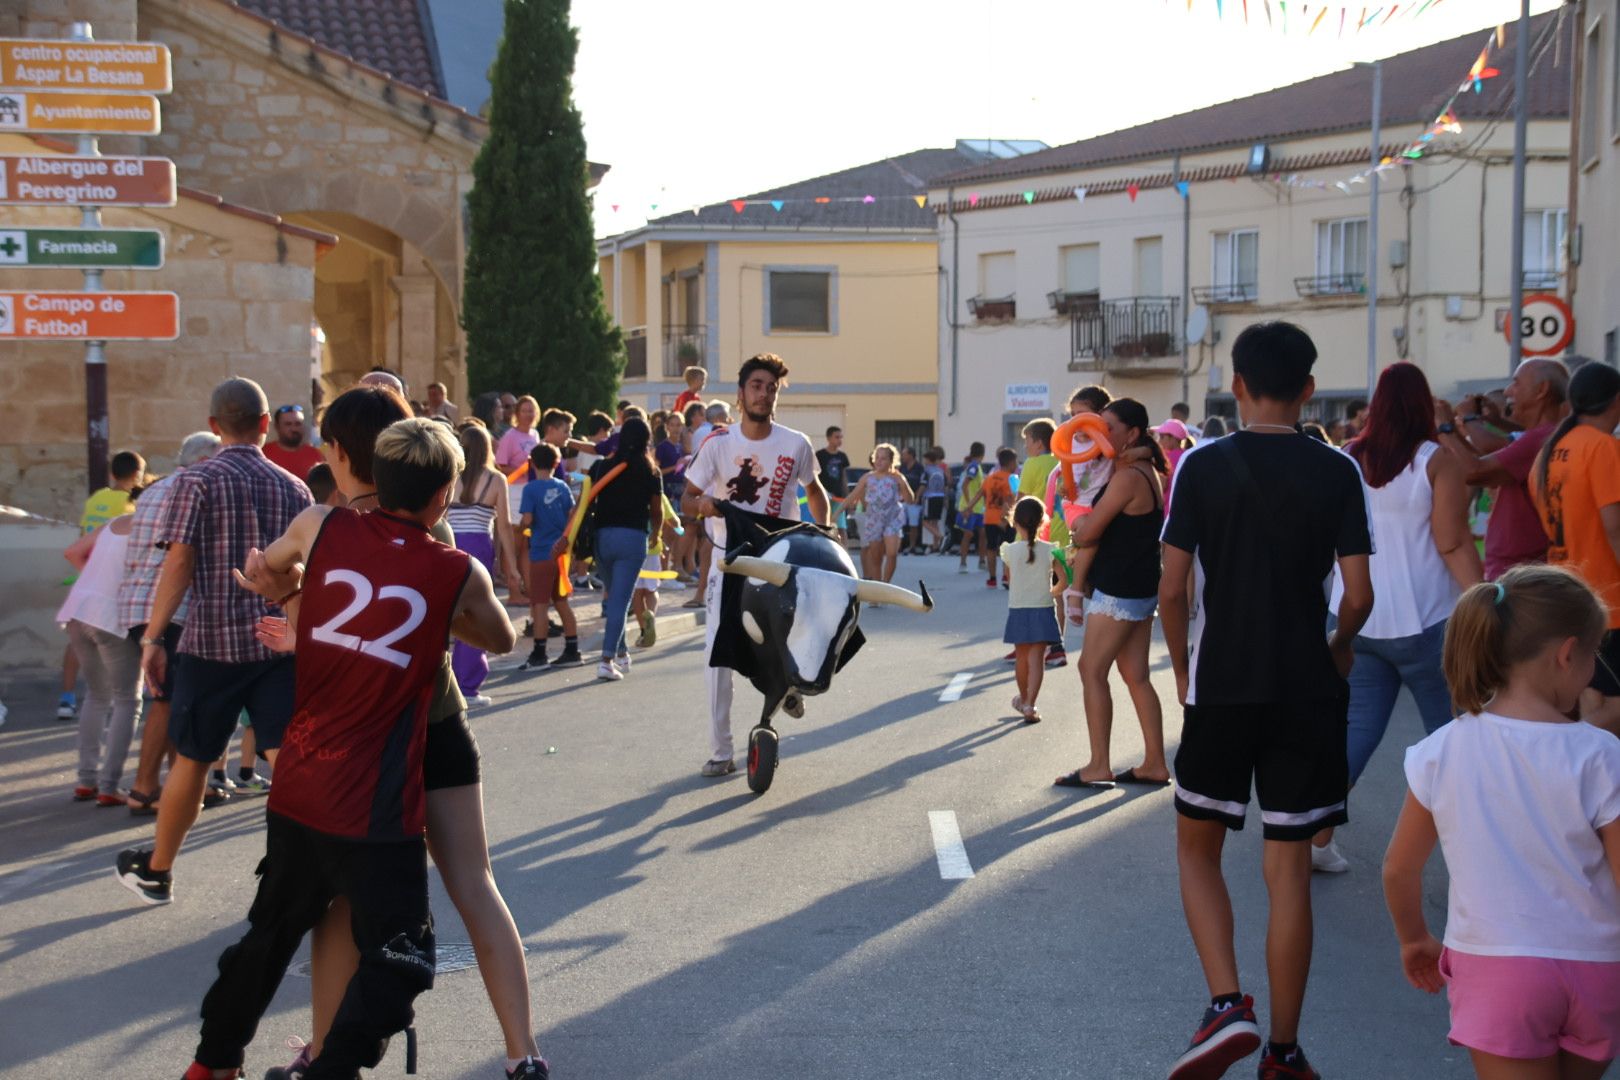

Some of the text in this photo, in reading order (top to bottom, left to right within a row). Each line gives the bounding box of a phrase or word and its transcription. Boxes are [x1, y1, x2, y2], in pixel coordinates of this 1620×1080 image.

[12, 45, 157, 64] centro ocupacional
[15, 64, 145, 85] Aspar La Besana
[33, 104, 152, 121] Ayuntamiento
[16, 158, 144, 179] Albergue del
[18, 182, 118, 203] Peregrino
[38, 239, 118, 254] Farmacia
[23, 294, 126, 315] Campo de
[24, 318, 88, 335] Futbol
[1519, 316, 1559, 337] 30
[311, 568, 428, 669] 22
